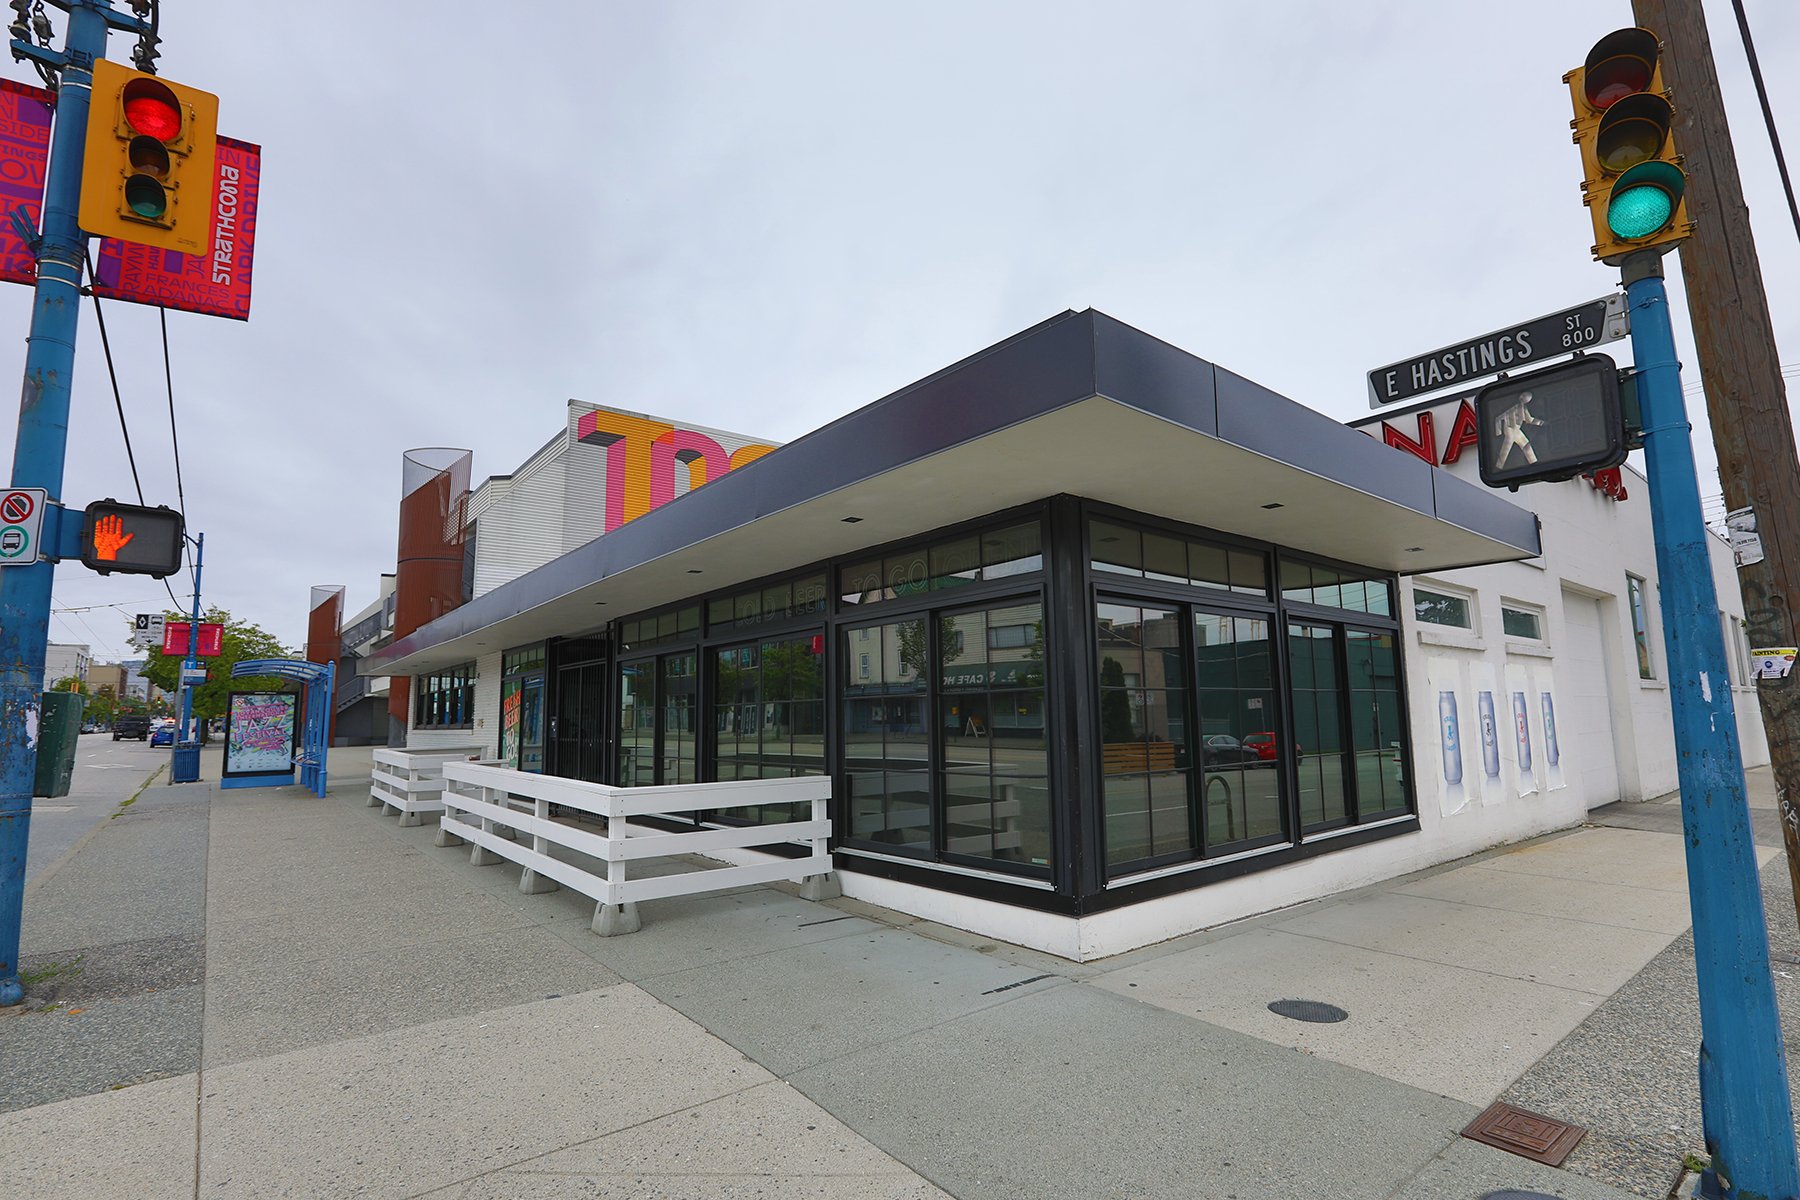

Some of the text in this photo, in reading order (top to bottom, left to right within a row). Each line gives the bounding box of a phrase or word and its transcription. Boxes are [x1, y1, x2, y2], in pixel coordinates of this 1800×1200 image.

[146, 273, 230, 299] FRANCES
[1565, 313, 1582, 330] ST
[1561, 326, 1595, 347] 800
[1385, 330, 1533, 397] E HASTINGS
[888, 558, 929, 593] GO
[235, 714, 289, 733] JAZZ
